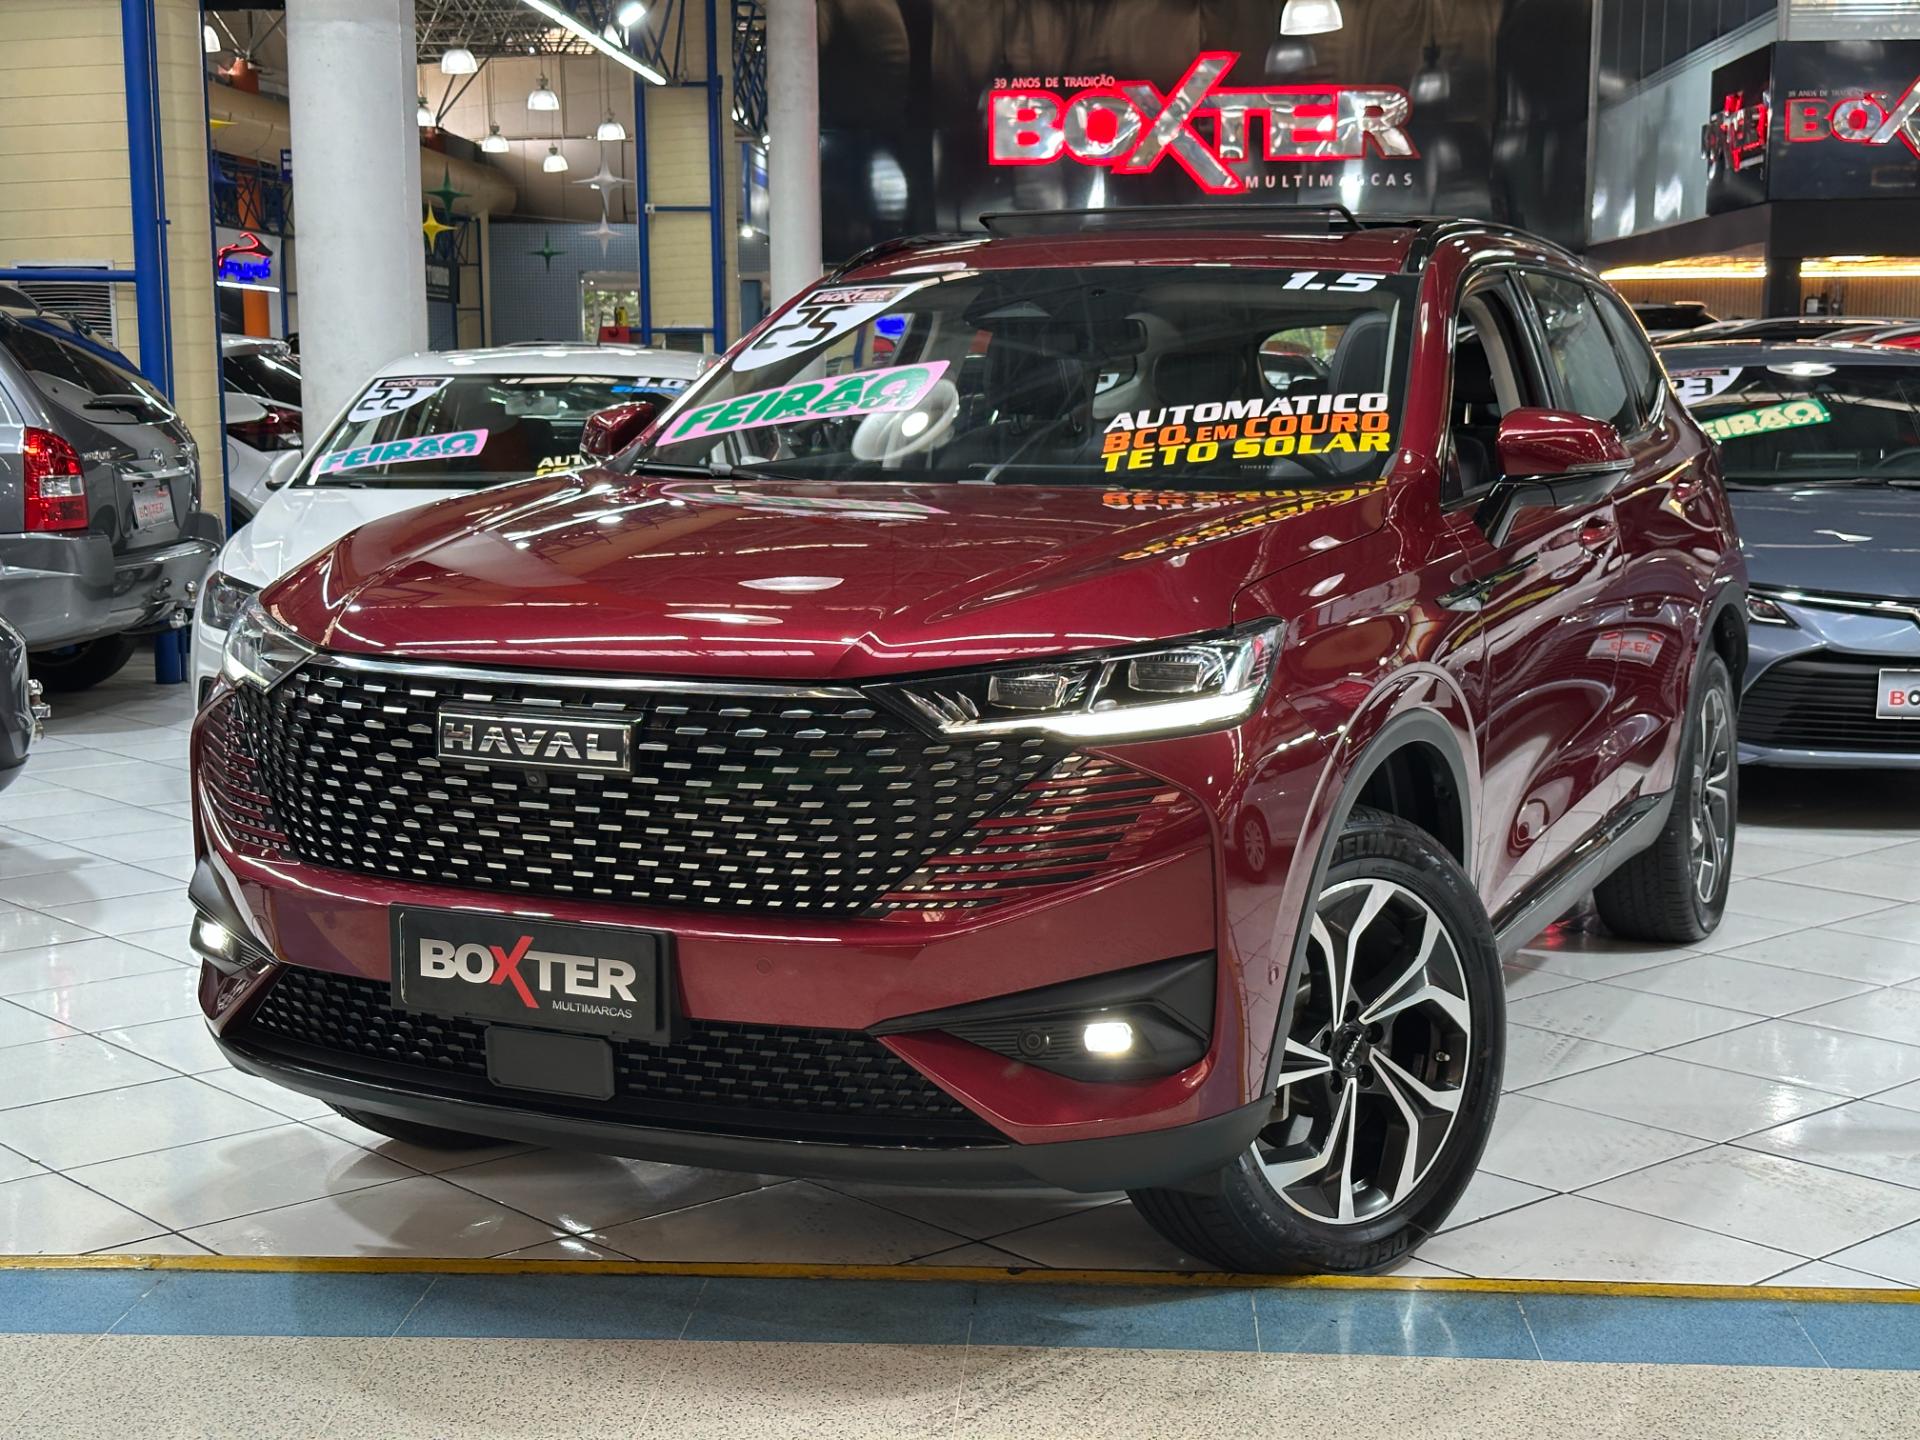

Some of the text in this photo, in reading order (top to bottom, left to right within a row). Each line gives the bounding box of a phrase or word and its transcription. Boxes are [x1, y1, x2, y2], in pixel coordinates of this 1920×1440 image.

[993, 74, 1116, 89] 39 ANOS DE TRADIÇÃO
[989, 52, 1421, 194] BOXTER
[1282, 271, 1387, 292] 1.5
[752, 304, 856, 351] 25
[357, 388, 419, 411] 22
[672, 367, 931, 439] FEIRÃO
[1196, 424, 1238, 442] EM
[1244, 412, 1389, 438] COURO
[320, 433, 478, 472] FEIRÃO
[1101, 432, 1390, 473] TETO SOLAR
[443, 722, 618, 762] HAVAL
[419, 935, 638, 1009] BOXTER
[551, 999, 633, 1019] MULTIMARCAS
